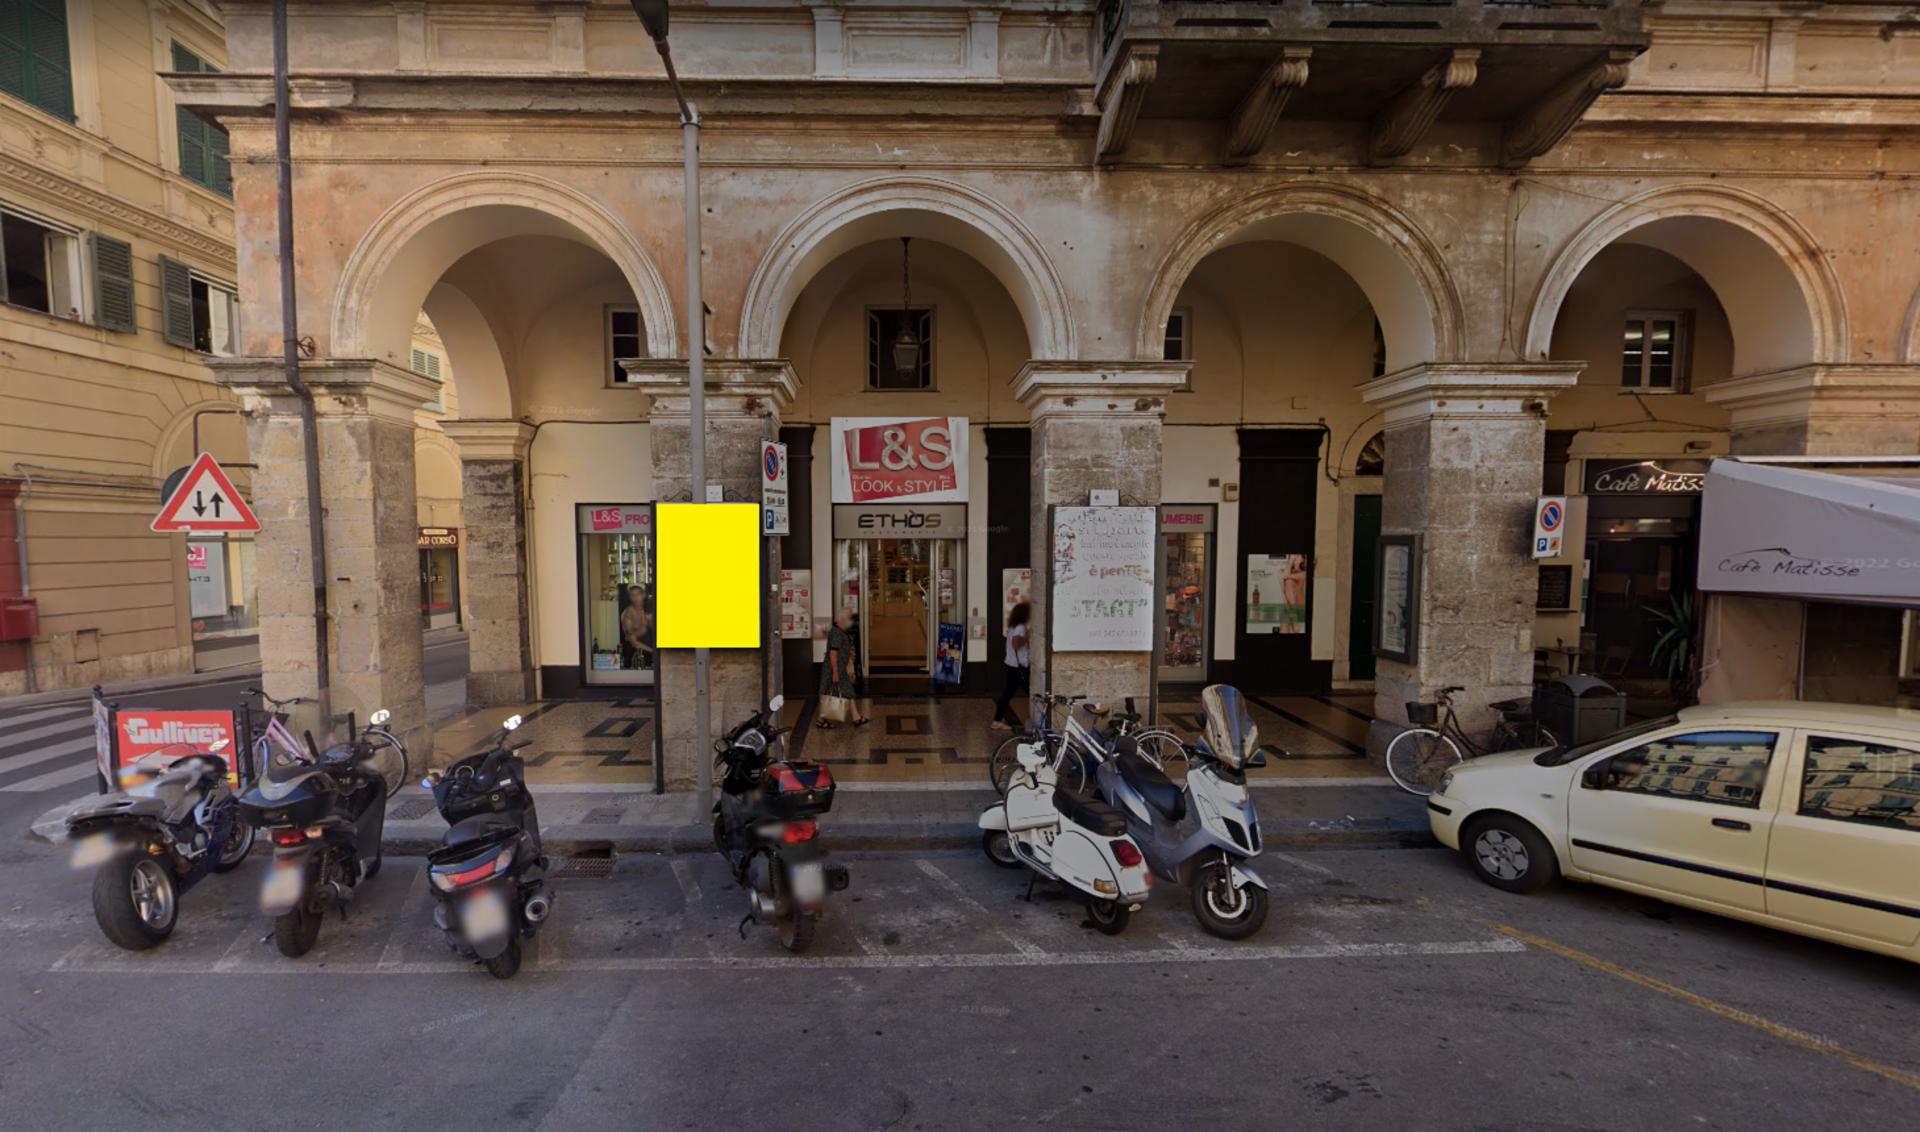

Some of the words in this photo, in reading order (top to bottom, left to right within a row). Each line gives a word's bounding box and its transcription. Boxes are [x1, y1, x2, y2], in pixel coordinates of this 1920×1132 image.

[851, 426, 953, 472] L&S
[853, 480, 894, 493] LOOK
[904, 480, 951, 493] STYLE
[593, 510, 622, 522] L&S
[624, 514, 650, 525] PRO
[431, 534, 456, 545] CORSO
[1772, 560, 1861, 577] Matisse
[124, 718, 226, 745] Gulliver
